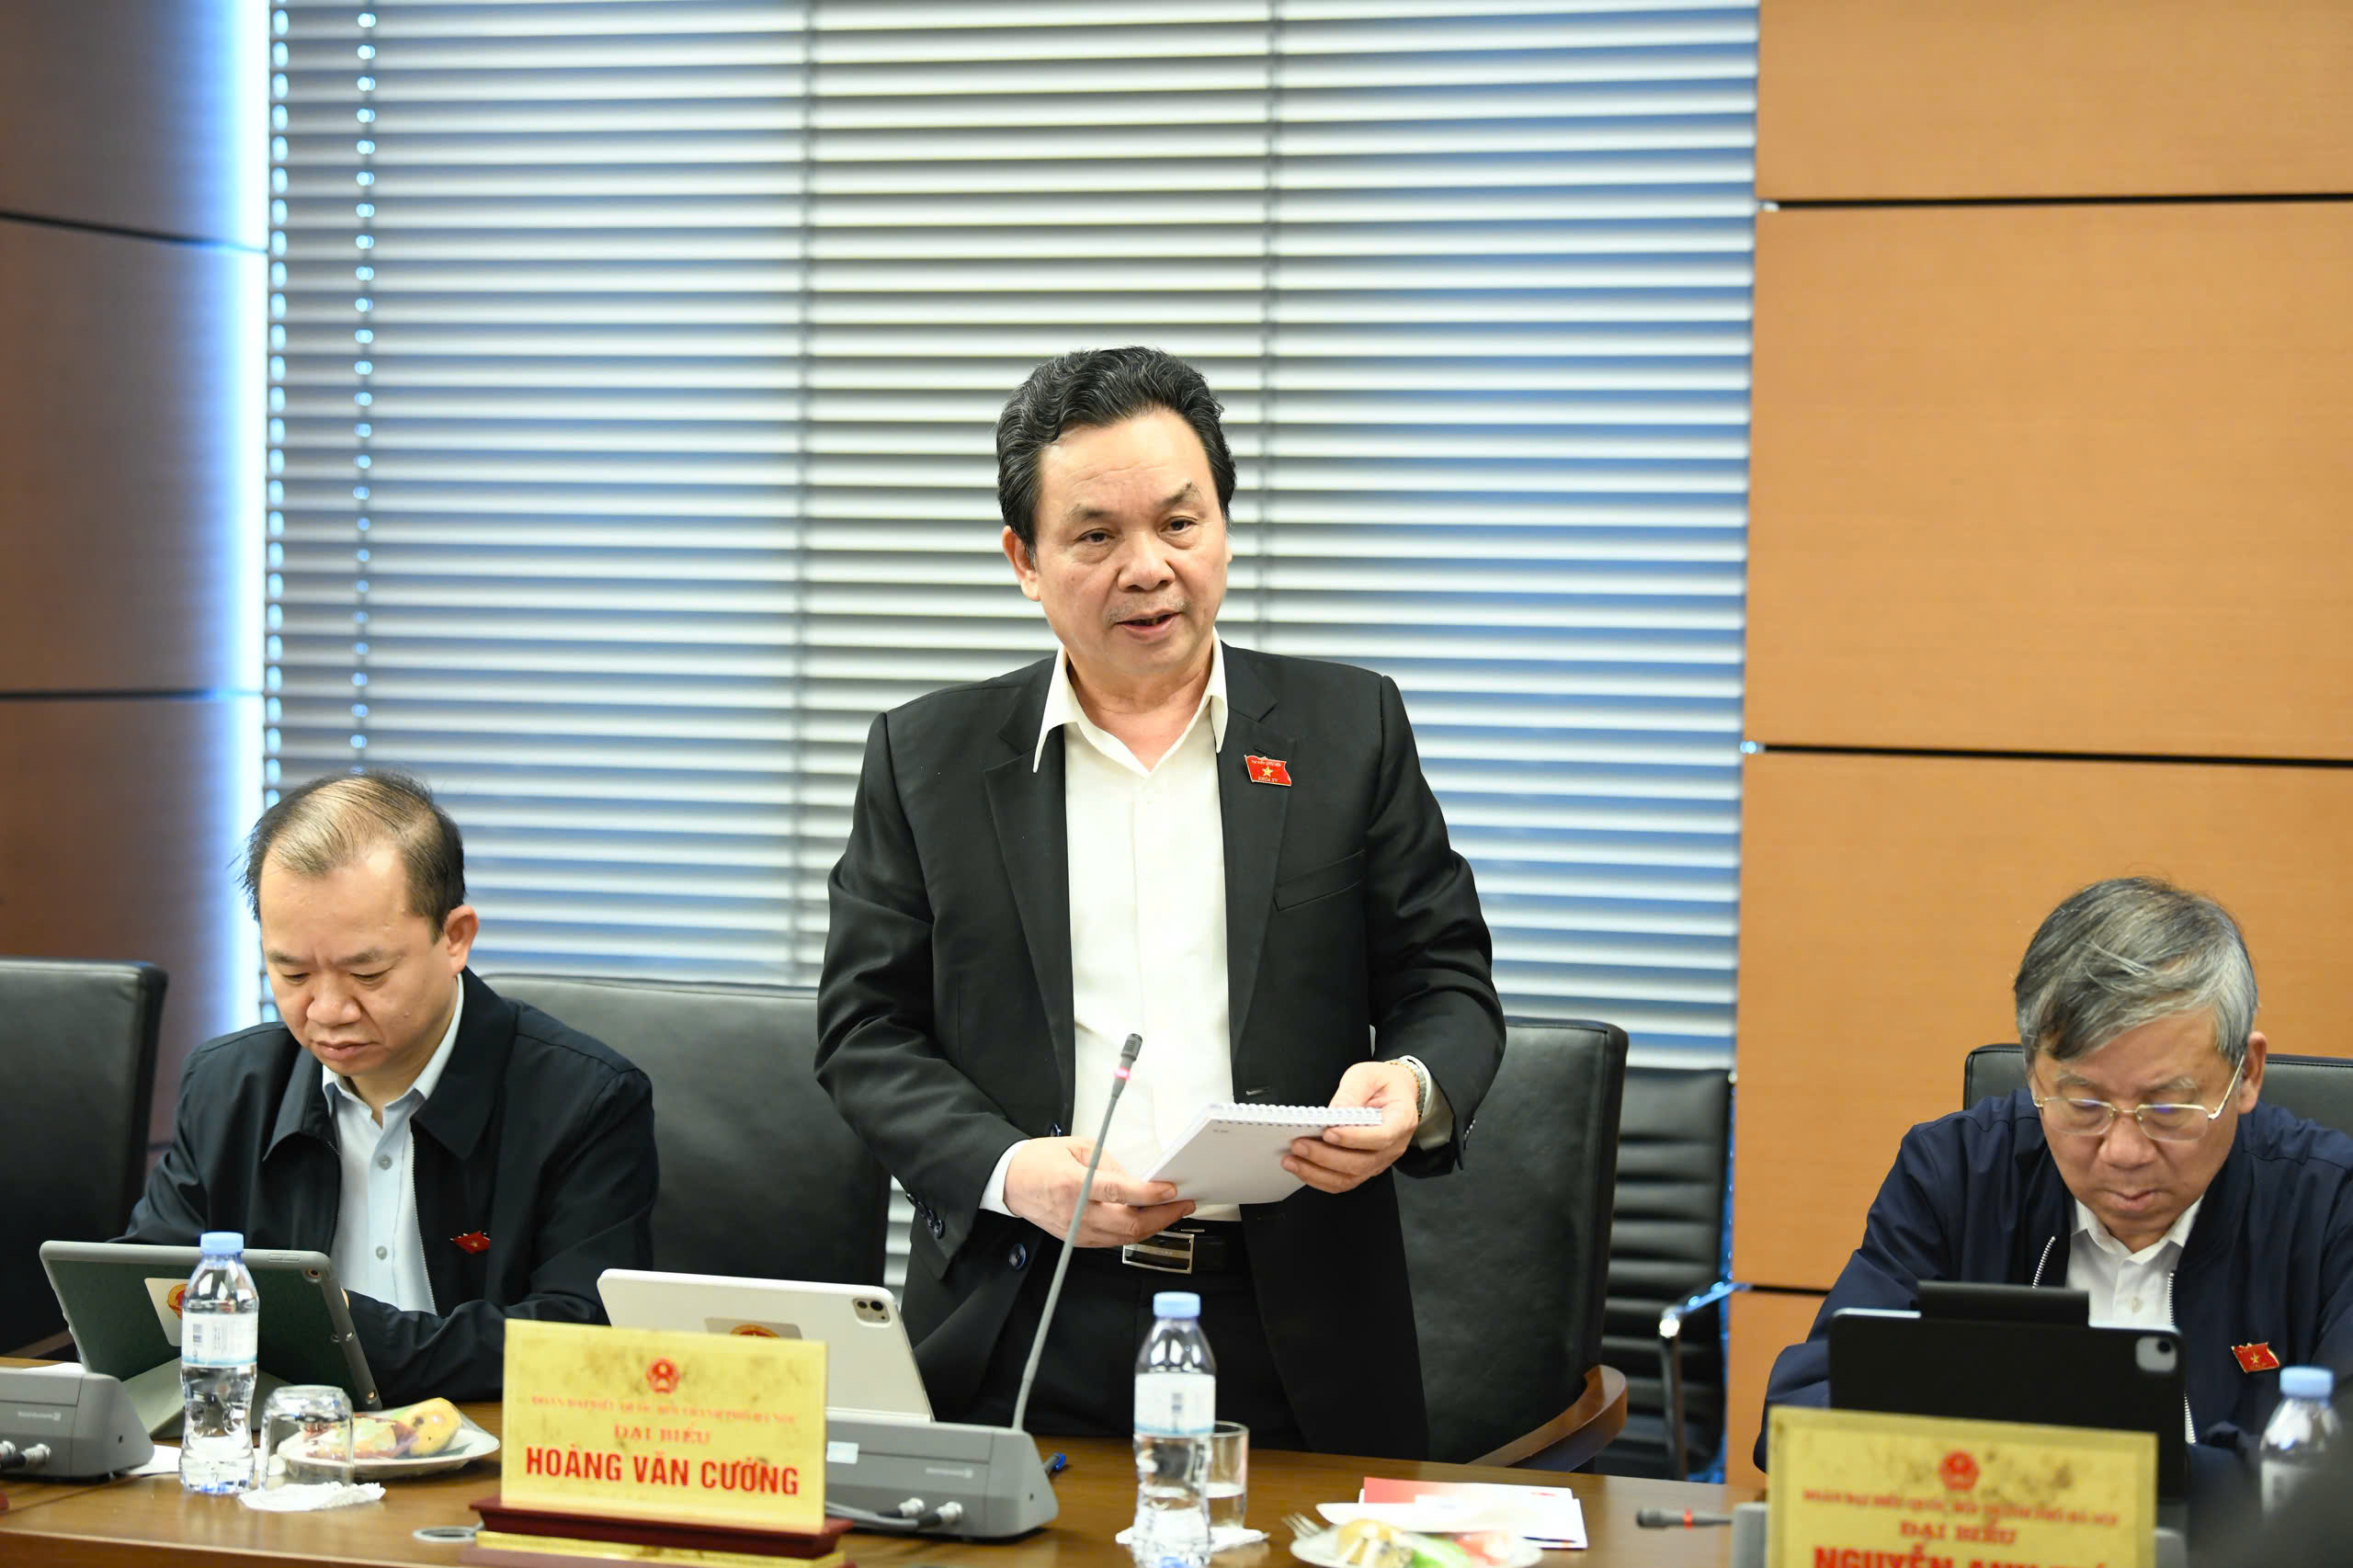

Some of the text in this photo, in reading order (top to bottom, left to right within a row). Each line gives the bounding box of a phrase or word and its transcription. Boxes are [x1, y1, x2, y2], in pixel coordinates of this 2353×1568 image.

[526, 1443, 798, 1496] HOÀNG VĂN CƯỜNG
